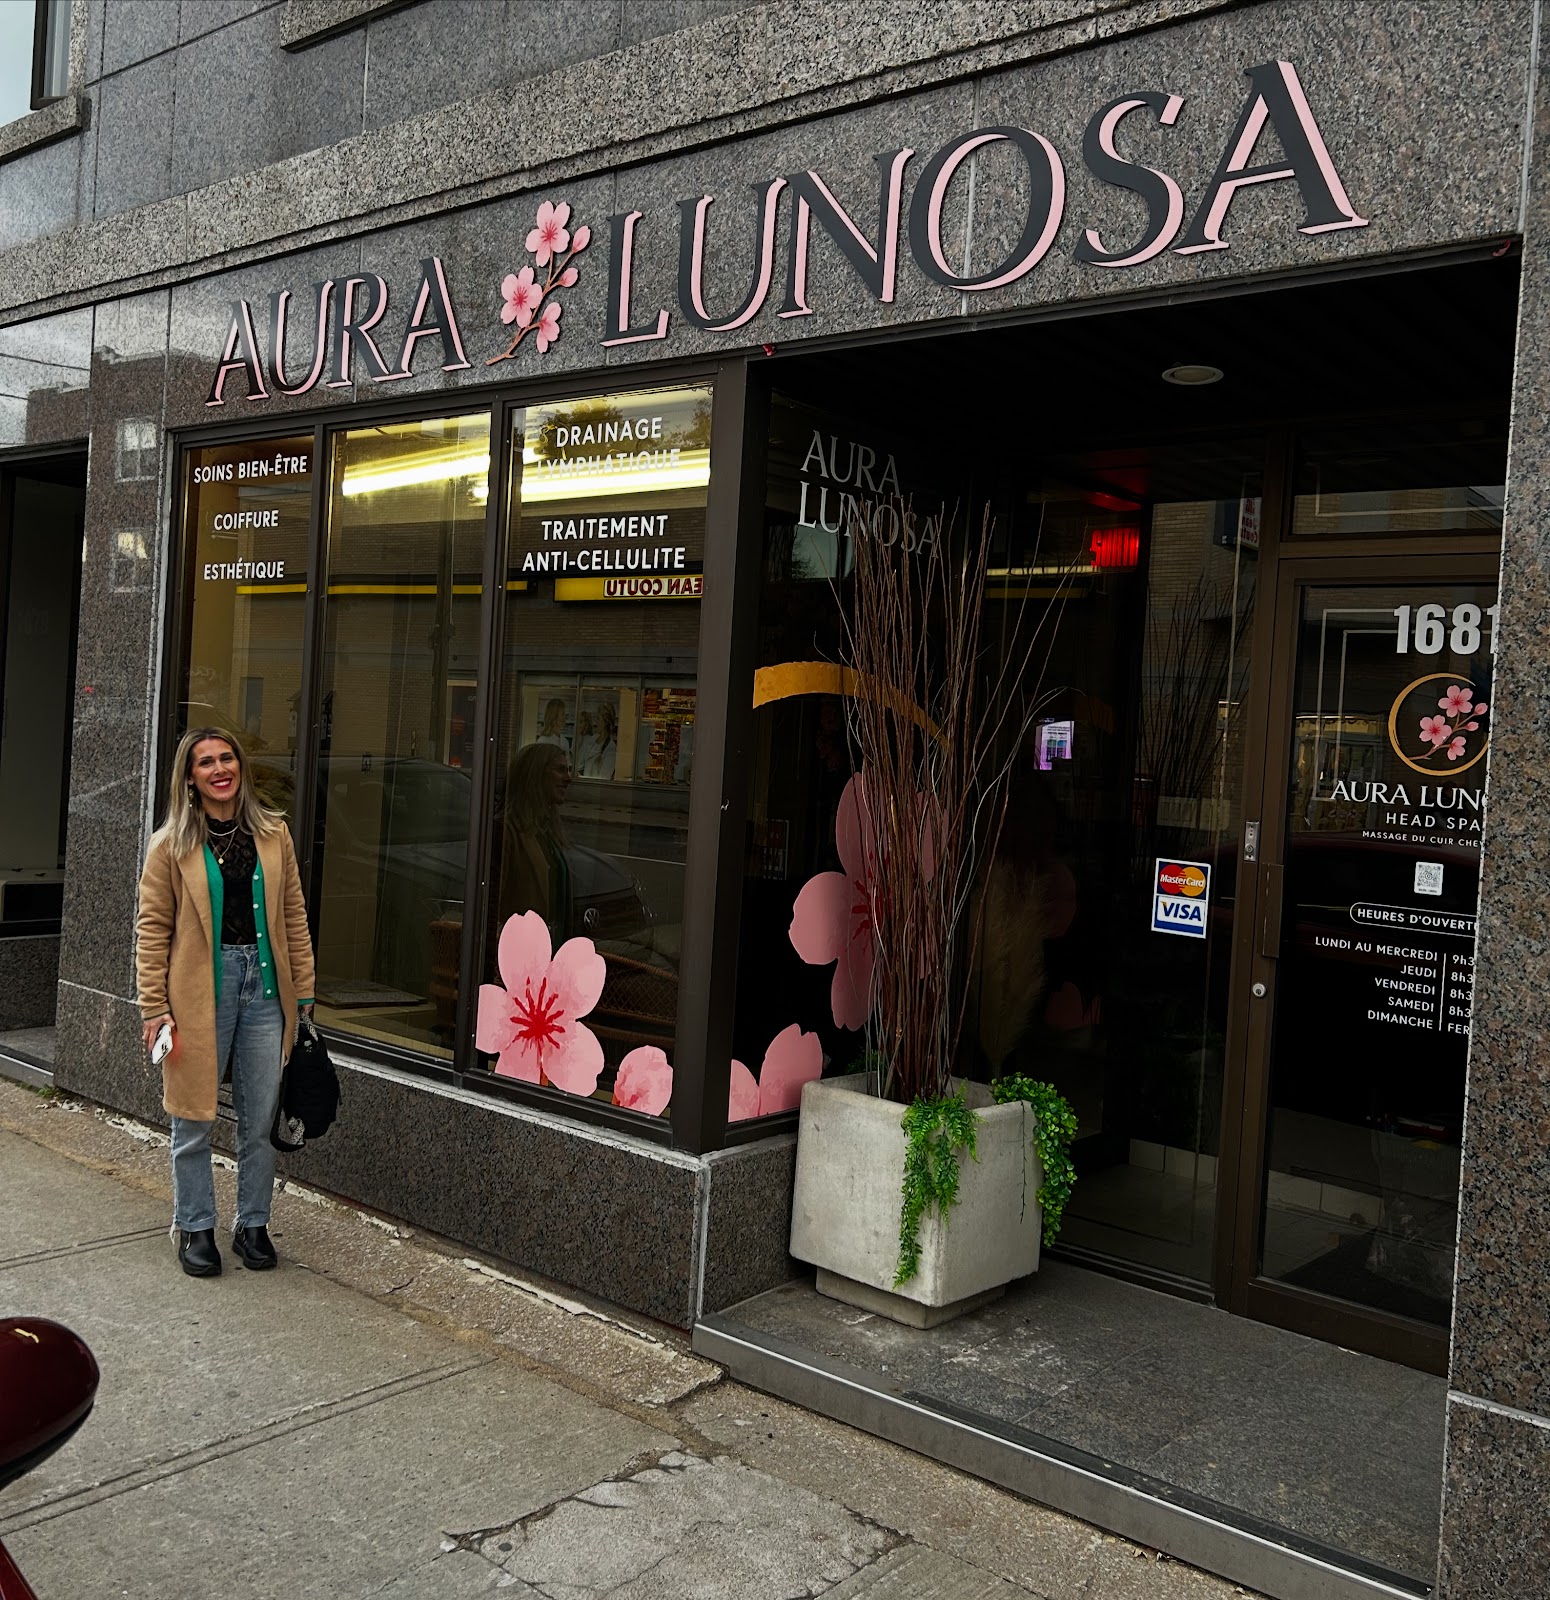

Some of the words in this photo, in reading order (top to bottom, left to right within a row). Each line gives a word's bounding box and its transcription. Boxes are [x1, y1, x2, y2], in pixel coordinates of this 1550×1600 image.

[205, 256, 471, 407] AURA
[600, 60, 1369, 347] LUNOSA
[556, 416, 663, 447] DRAINAGE
[194, 464, 233, 483] SOINS
[238, 453, 308, 479] BIEN-ÊTRE
[537, 448, 681, 479] LYMPHATIQUE
[800, 429, 902, 498] AURA
[214, 510, 279, 530] COIFFURE
[541, 514, 668, 541] TRAITEMENT
[798, 480, 939, 559] LUNOSA
[203, 557, 285, 580] ESTHÉTIQUE
[522, 547, 686, 572] ANTI-CELLULITE
[1393, 603, 1500, 655] 1681
[1330, 780, 1411, 806] AURA
[1386, 812, 1435, 828] HEAD
[1446, 816, 1480, 832] SPA
[1362, 830, 1407, 841] MASSAGE
[1412, 834, 1426, 843] DU
[1430, 836, 1454, 845] CUIR
[1160, 873, 1205, 888] MasterCard
[1160, 901, 1202, 922] VISA
[1357, 908, 1405, 923] HEURES
[1315, 936, 1350, 950] LUNDI
[1355, 942, 1371, 952] AU
[1376, 944, 1438, 962] MERCREDI
[1400, 964, 1436, 979] JEUDI
[1374, 977, 1436, 996] VENDREDI
[1388, 996, 1434, 1012] SAMEDI
[1367, 1010, 1433, 1029] DIMANCHE
